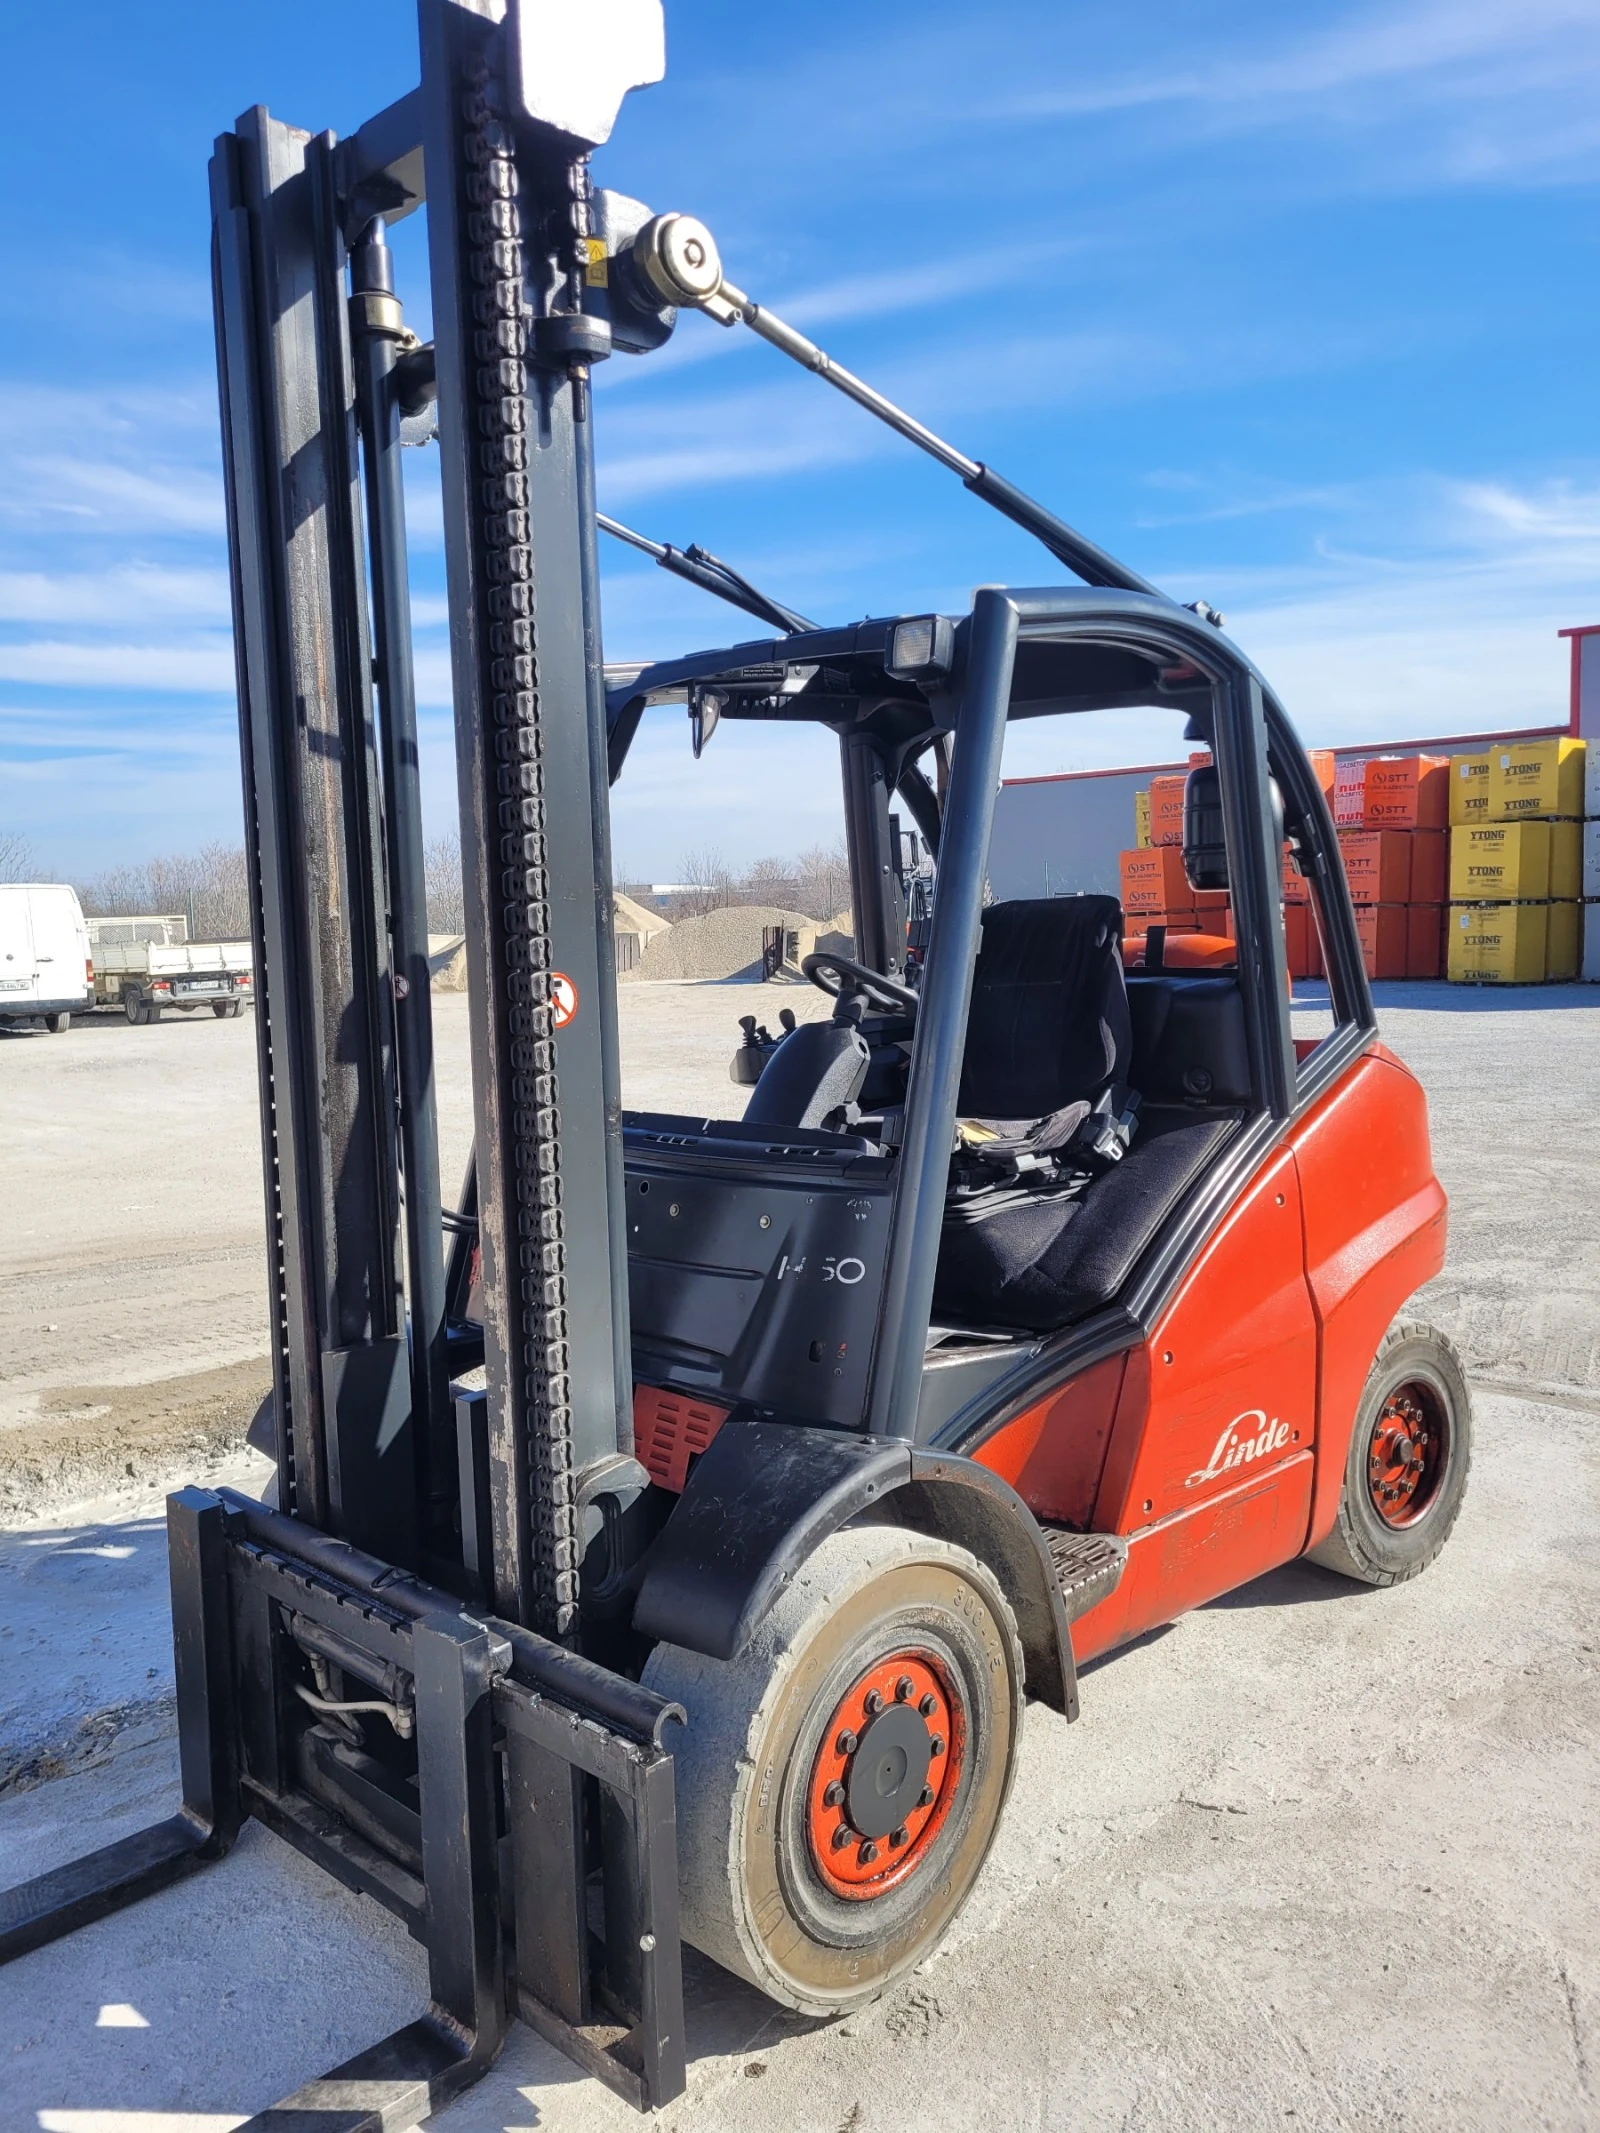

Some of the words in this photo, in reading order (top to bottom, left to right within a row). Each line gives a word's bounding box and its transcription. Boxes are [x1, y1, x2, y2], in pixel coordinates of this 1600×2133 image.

[1504, 763, 1541, 776] YTONG
[1389, 774, 1409, 782] STT
[1386, 805, 1407, 813] STT
[1504, 799, 1541, 811] YTONG
[1470, 830, 1505, 840] YTONG
[1140, 863, 1156, 871] STT
[1349, 859, 1371, 867] STT
[1468, 866, 1503, 877] YTONG
[1141, 892, 1157, 900] STT
[1464, 935, 1500, 945] YTONG
[1184, 1409, 1289, 1488] Linde
